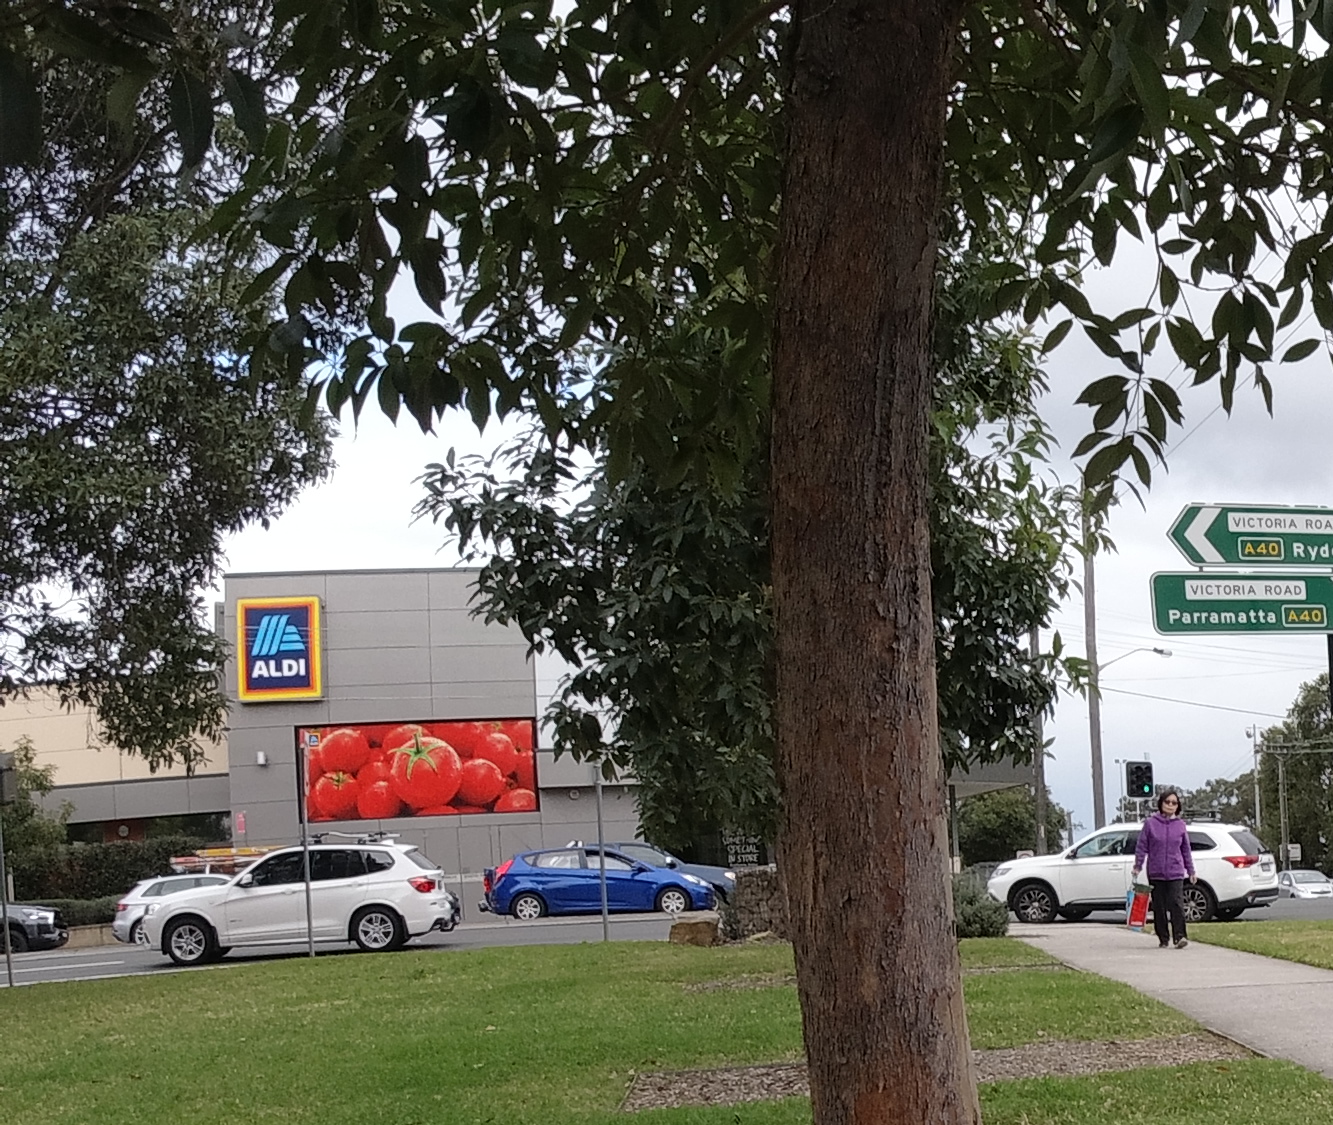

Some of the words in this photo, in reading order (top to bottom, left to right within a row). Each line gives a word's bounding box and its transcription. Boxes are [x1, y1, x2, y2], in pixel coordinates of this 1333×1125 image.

[1232, 517, 1298, 529] VICTORIA
[1244, 543, 1279, 555] A40
[1190, 584, 1257, 596] VICTORIA
[1264, 584, 1302, 596] ROAD
[1168, 609, 1277, 624] Parramatta
[1287, 609, 1322, 622] A40
[251, 658, 306, 678] ALDI
